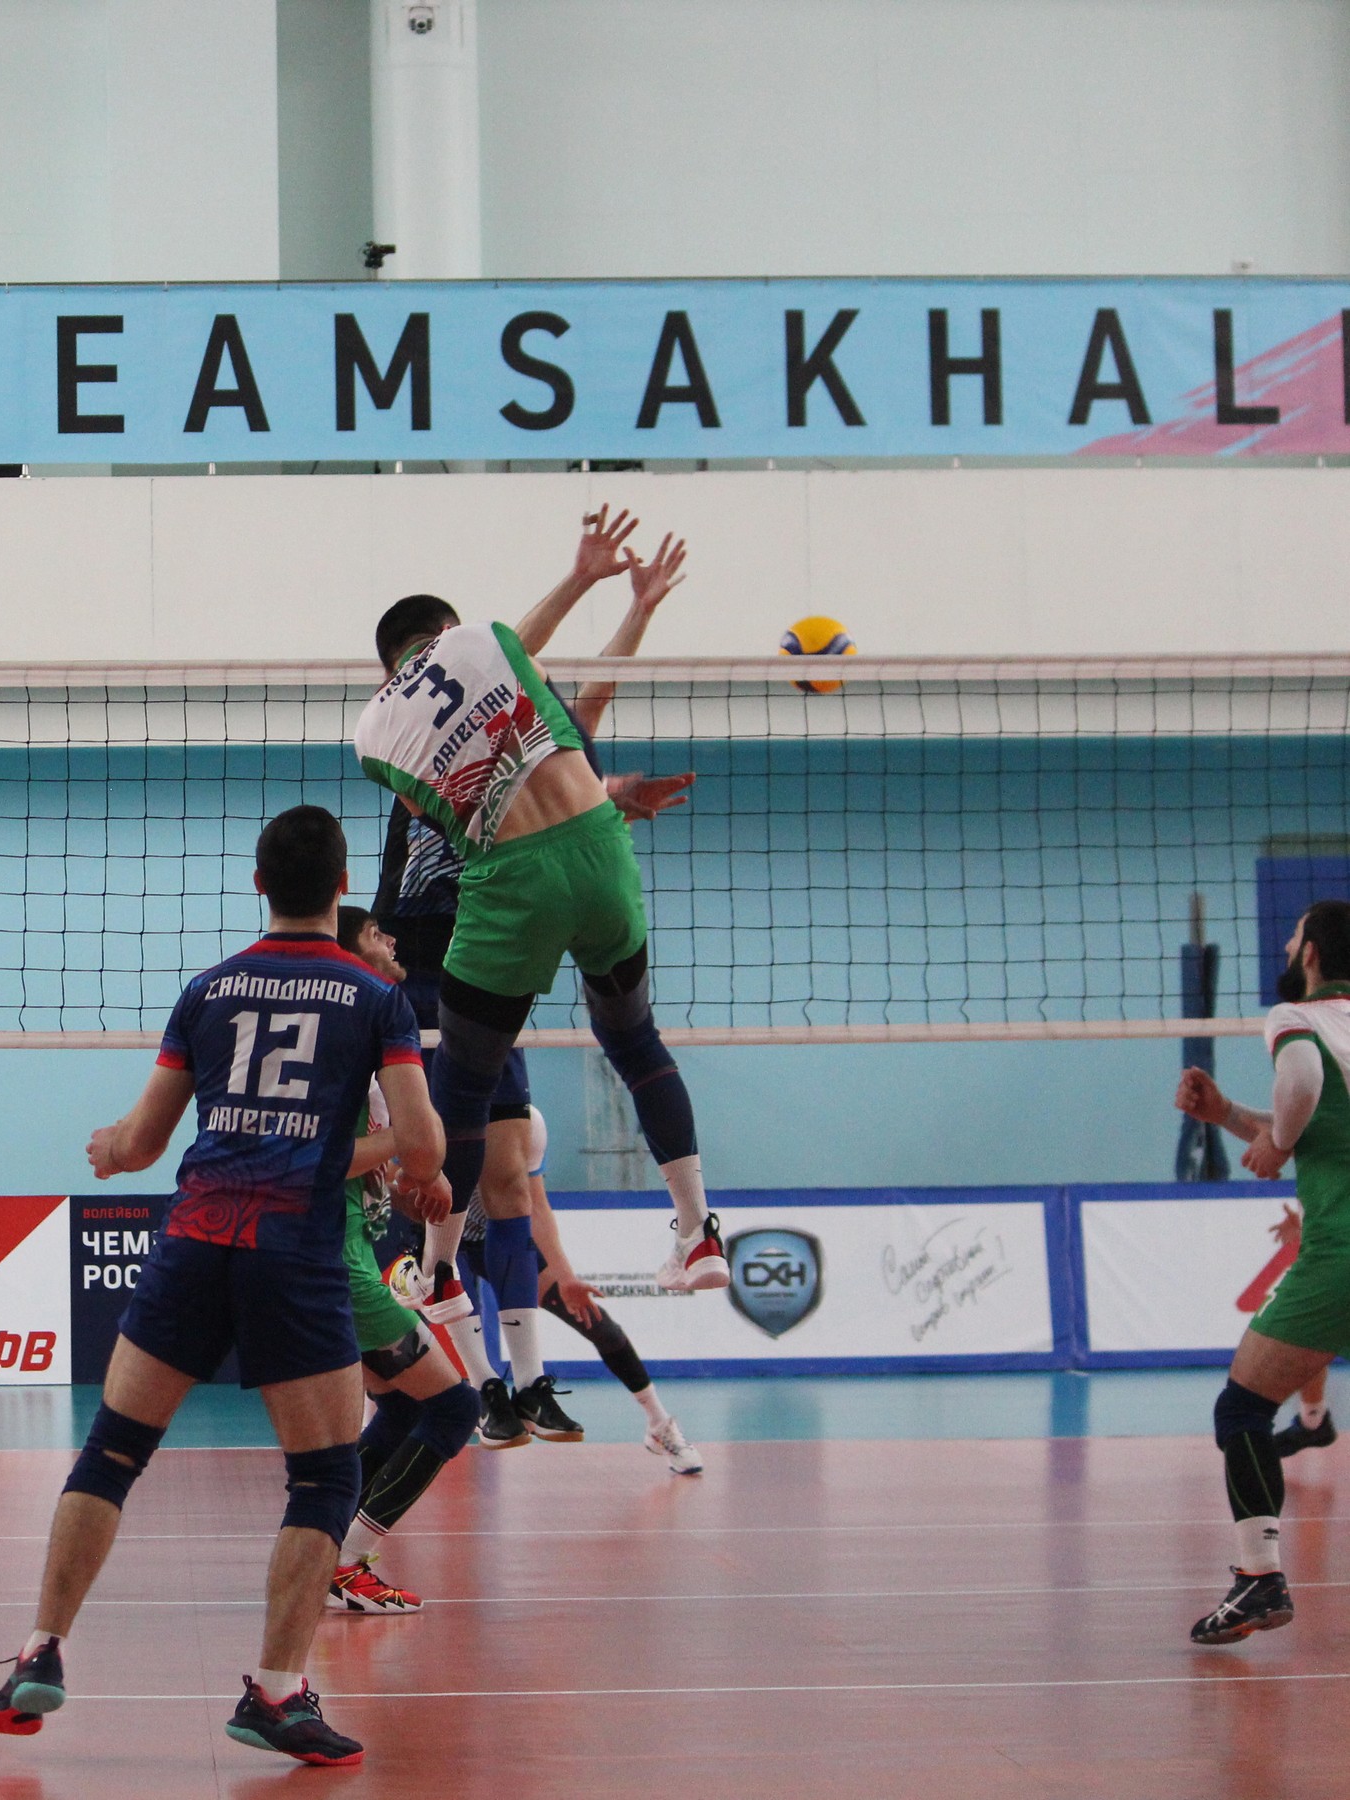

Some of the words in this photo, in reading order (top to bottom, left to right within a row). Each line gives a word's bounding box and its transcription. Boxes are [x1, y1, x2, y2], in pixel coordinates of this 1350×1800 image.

[402, 663, 465, 730] 3
[433, 683, 514, 777] ДАГЕСТАН
[205, 972, 358, 1007] САЙПОДИНОВ
[229, 1010, 321, 1100] 12
[206, 1106, 320, 1139] ДАГЕСТАН
[82, 1206, 150, 1220] ВОЛЕЙБОЛ
[82, 1230, 158, 1256] ЧЕМ
